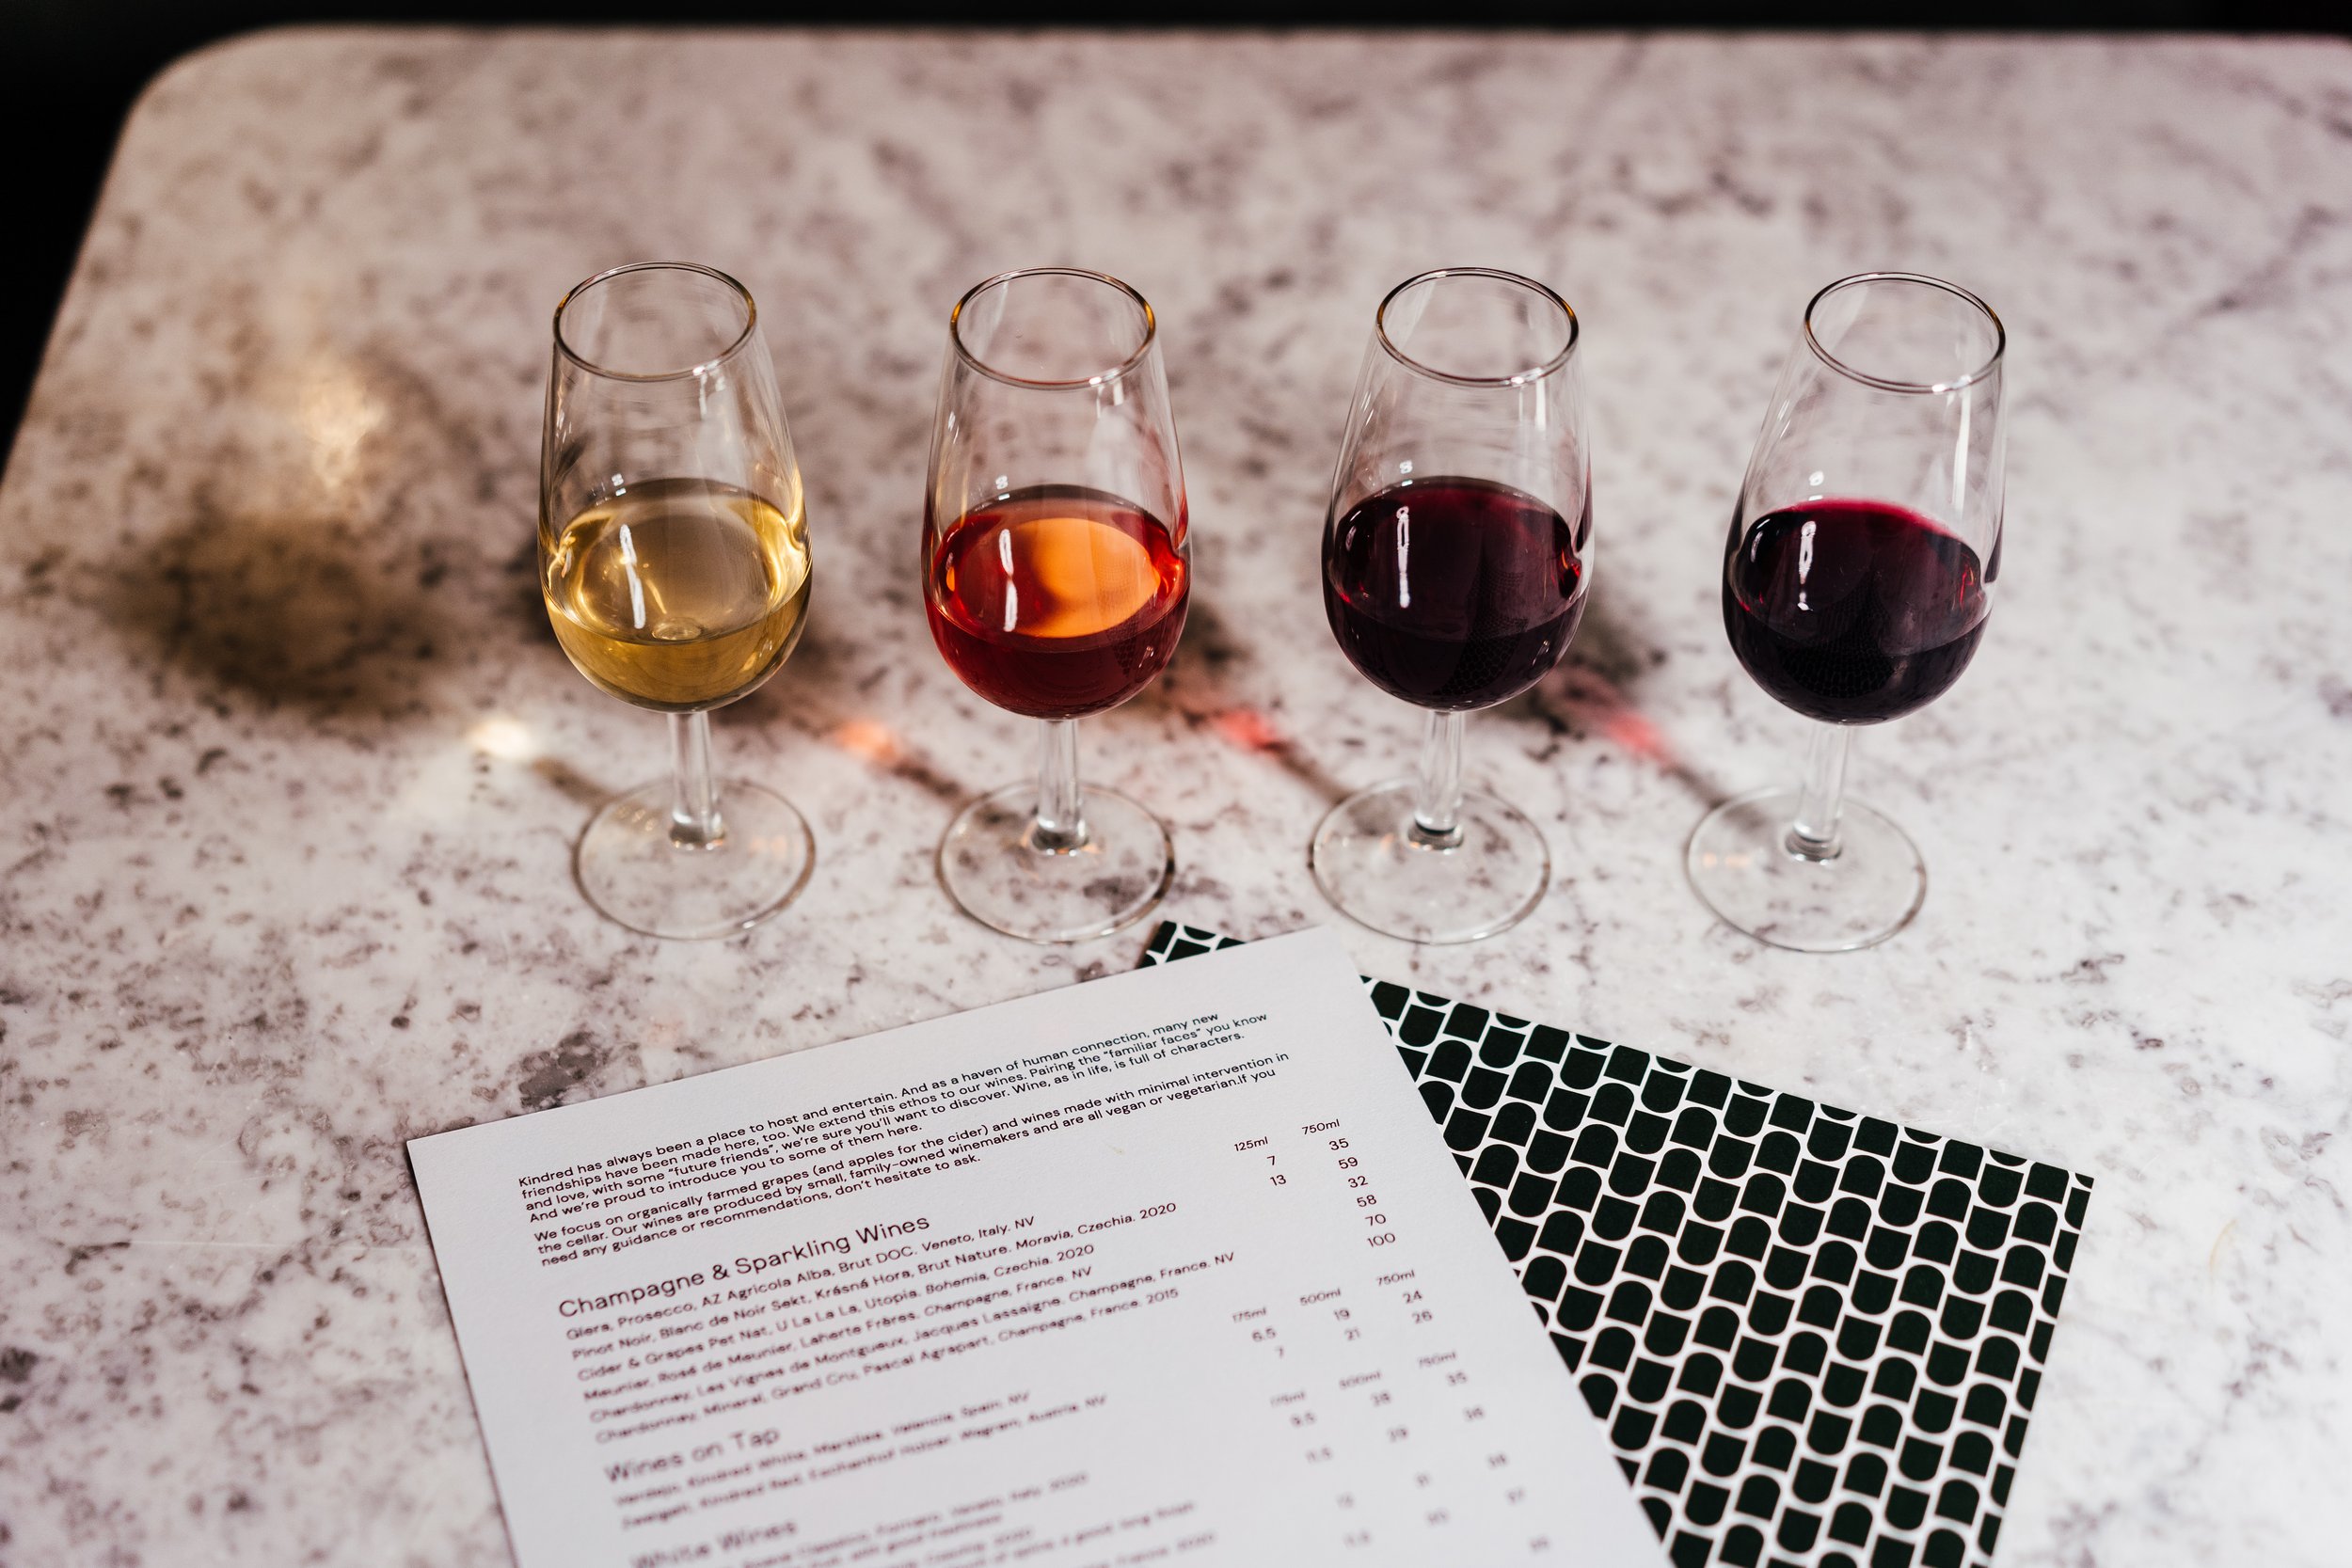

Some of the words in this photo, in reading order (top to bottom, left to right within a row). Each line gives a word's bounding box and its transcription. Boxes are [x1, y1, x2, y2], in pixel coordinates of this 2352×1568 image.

[518, 1166, 574, 1188] Kindred
[577, 1162, 603, 1175] has
[606, 1150, 653, 1167] always
[655, 1141, 692, 1156] been
[695, 1138, 705, 1147] a
[707, 1128, 746, 1146] place
[749, 1124, 765, 1133] to
[767, 1115, 800, 1129] host
[802, 1106, 829, 1121] and
[832, 1092, 898, 1114] entertain.
[901, 1082, 929, 1098] And
[931, 1080, 947, 1090] as
[950, 1077, 960, 1085] a
[961, 1067, 1003, 1083] haven
[1006, 1060, 1019, 1071] of
[1022, 1051, 1069, 1068] human
[1072, 1031, 1150, 1055] connection,
[1152, 1021, 1188, 1036] many
[1192, 1013, 1218, 1026] new
[521, 1175, 602, 1199] friendships
[604, 1166, 639, 1180] have
[641, 1157, 678, 1171] been
[681, 1146, 722, 1163] made
[723, 1138, 759, 1152] here,
[762, 1131, 790, 1143] too.
[791, 1123, 816, 1135] We
[818, 1109, 866, 1129] extend
[868, 1104, 896, 1117] this
[898, 1095, 938, 1110] ethos
[940, 1090, 956, 1100] to
[959, 1084, 980, 1095] our
[984, 1073, 1027, 1089] wines.
[1028, 1061, 1076, 1078] Pairing
[1077, 1054, 1101, 1066] the
[1205, 1023, 1231, 1037] you
[1232, 1014, 1267, 1028] know
[525, 1196, 553, 1212] and
[555, 1191, 589, 1204] love,
[592, 1181, 623, 1196] with
[627, 1172, 665, 1188] some
[821, 1128, 852, 1141] sure
[894, 1109, 929, 1123] want
[930, 1105, 946, 1115] to
[949, 1089, 1010, 1110] discover.
[1011, 1080, 1051, 1094] Wine,
[1054, 1074, 1070, 1085] as
[1071, 1070, 1086, 1080] in
[1087, 1065, 1112, 1076] life,
[1113, 1060, 1126, 1069] is
[1128, 1053, 1151, 1066] full
[1152, 1049, 1167, 1060] of
[1170, 1033, 1245, 1055] characters.
[1301, 1118, 1341, 1135] 750ml
[533, 1230, 558, 1243] We
[561, 1221, 601, 1236] focus
[605, 1215, 624, 1226] on
[627, 1196, 703, 1221] organically
[707, 1180, 758, 1201] farmed
[761, 1170, 810, 1191] grapes
[812, 1160, 845, 1177] (and
[848, 1149, 895, 1167] apples
[898, 1144, 917, 1155] for
[920, 1138, 945, 1149] the
[947, 1124, 989, 1143] cider)
[992, 1117, 1019, 1132] and
[1021, 1109, 1061, 1125] wines
[1063, 1099, 1103, 1115] made
[1104, 1090, 1136, 1104] with
[1137, 1075, 1191, 1097] minimal
[1192, 1057, 1274, 1083] intervention
[1275, 1053, 1290, 1062] in
[1233, 1135, 1268, 1152] 125ml
[1328, 1137, 1349, 1151] 35
[537, 1243, 563, 1255] the
[565, 1232, 609, 1248] cellar.
[612, 1224, 638, 1237] Our
[642, 1213, 683, 1230] wines
[687, 1208, 709, 1219] are
[713, 1187, 783, 1215] produced
[785, 1184, 803, 1196] by
[807, 1172, 848, 1190] small,
[947, 1130, 1030, 1155] winemakers
[1032, 1119, 1059, 1134] and
[1062, 1116, 1085, 1128] are
[1087, 1109, 1104, 1121] all
[1104, 1101, 1147, 1117] vegan
[1149, 1096, 1163, 1106] or
[1249, 1069, 1276, 1084] you
[1266, 1155, 1276, 1166] 7
[1338, 1156, 1359, 1170] 59
[530, 1208, 558, 1223] And
[603, 1187, 646, 1209] proud
[649, 1185, 665, 1195] to
[667, 1168, 737, 1190] introduce
[739, 1161, 767, 1175] you
[769, 1156, 785, 1165] to
[788, 1147, 827, 1162] some
[830, 1139, 844, 1151] of
[847, 1132, 885, 1147] them
[886, 1124, 923, 1137] here.
[1269, 1174, 1287, 1186] 13
[1347, 1175, 1369, 1189] 32
[1356, 1194, 1377, 1208] 58
[541, 1249, 579, 1267] need
[582, 1244, 608, 1258] any
[612, 1228, 677, 1253] guidance
[681, 1223, 695, 1233] or
[700, 1192, 832, 1229] recommendations,
[873, 1166, 931, 1186] hesitate
[934, 1162, 950, 1171] to
[953, 1153, 981, 1167] ask.
[1364, 1213, 1387, 1227] 70
[1367, 1232, 1396, 1247] 100
[558, 1273, 705, 1318] Champagne
[712, 1263, 730, 1281] &
[734, 1236, 851, 1275] Sparkling
[854, 1217, 930, 1244] Wines
[702, 1292, 722, 1307] AZ
[727, 1278, 792, 1301] Agricola
[837, 1258, 872, 1274] Brut
[1014, 1215, 1035, 1229] NV
[1402, 1290, 1423, 1305] 24
[1333, 1308, 1351, 1321] 19
[604, 1454, 684, 1483] Wines
[691, 1444, 723, 1462] on
[731, 1429, 780, 1449] Tap
